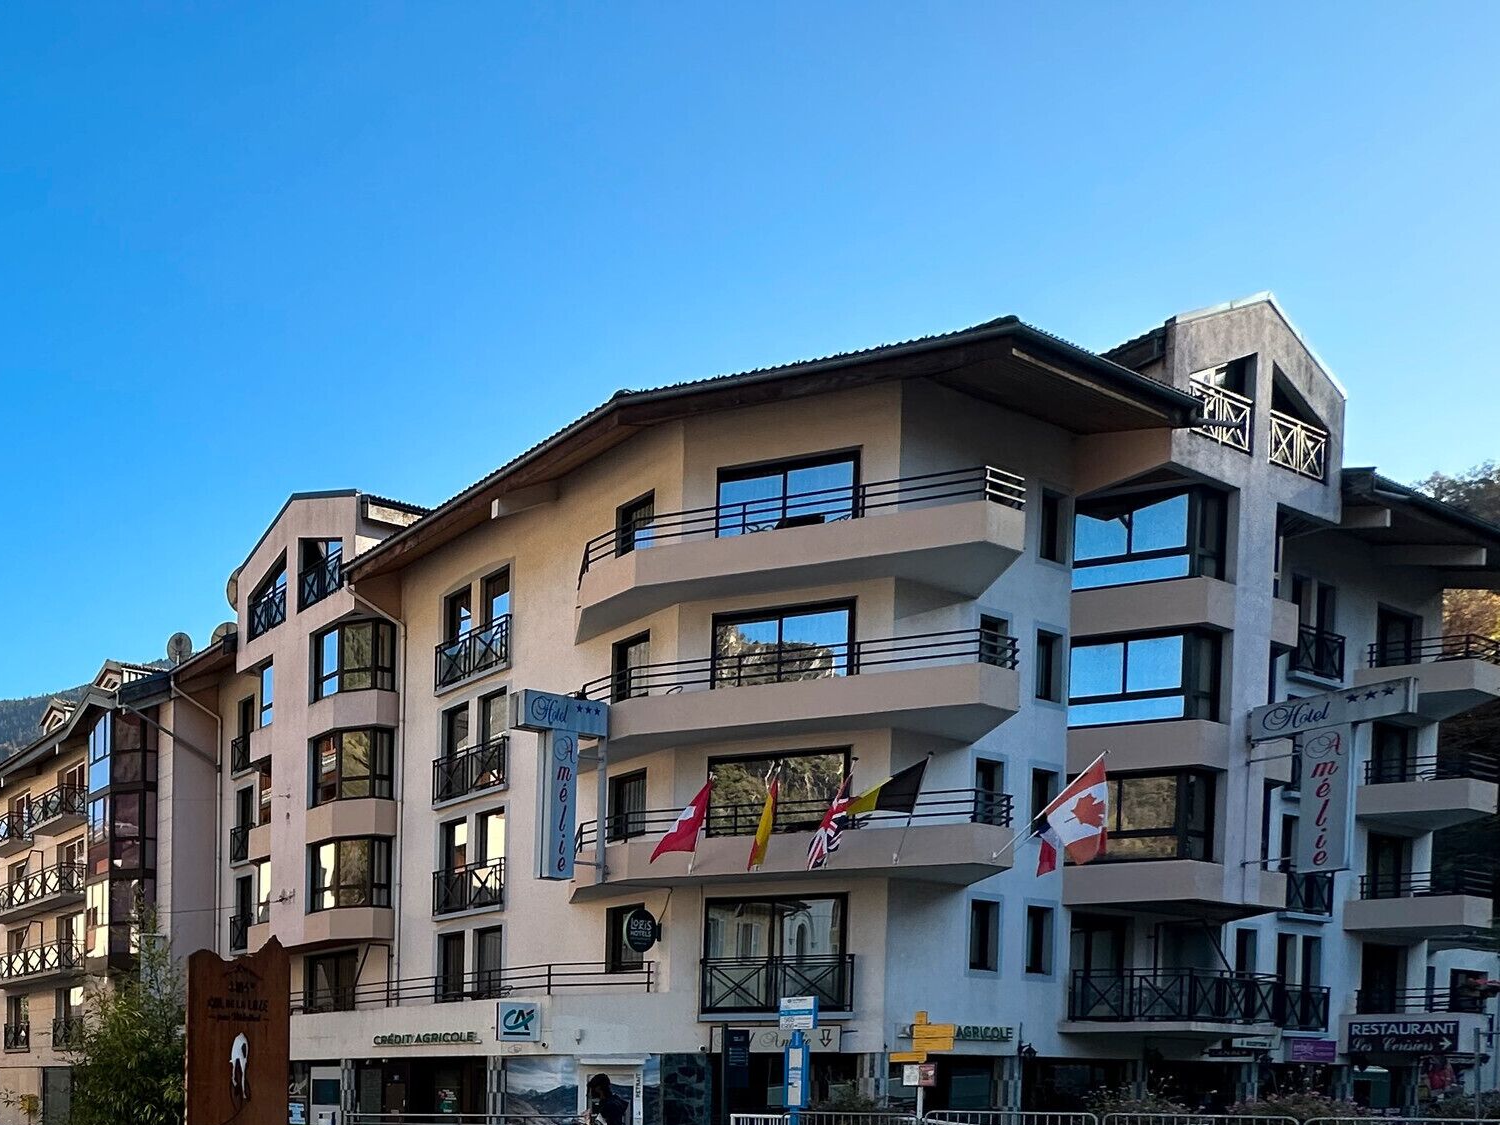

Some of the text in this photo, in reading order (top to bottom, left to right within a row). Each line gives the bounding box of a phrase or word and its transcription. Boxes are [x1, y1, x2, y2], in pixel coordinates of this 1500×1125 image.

[1262, 701, 1331, 731] Hotel
[553, 735, 577, 872] Amélie
[1304, 730, 1343, 866] Amélie
[373, 1031, 474, 1045] CRÉDIT AGRICOLE
[956, 1026, 1013, 1039] AGRICOLE
[1351, 1022, 1456, 1035] RESTAURANT
